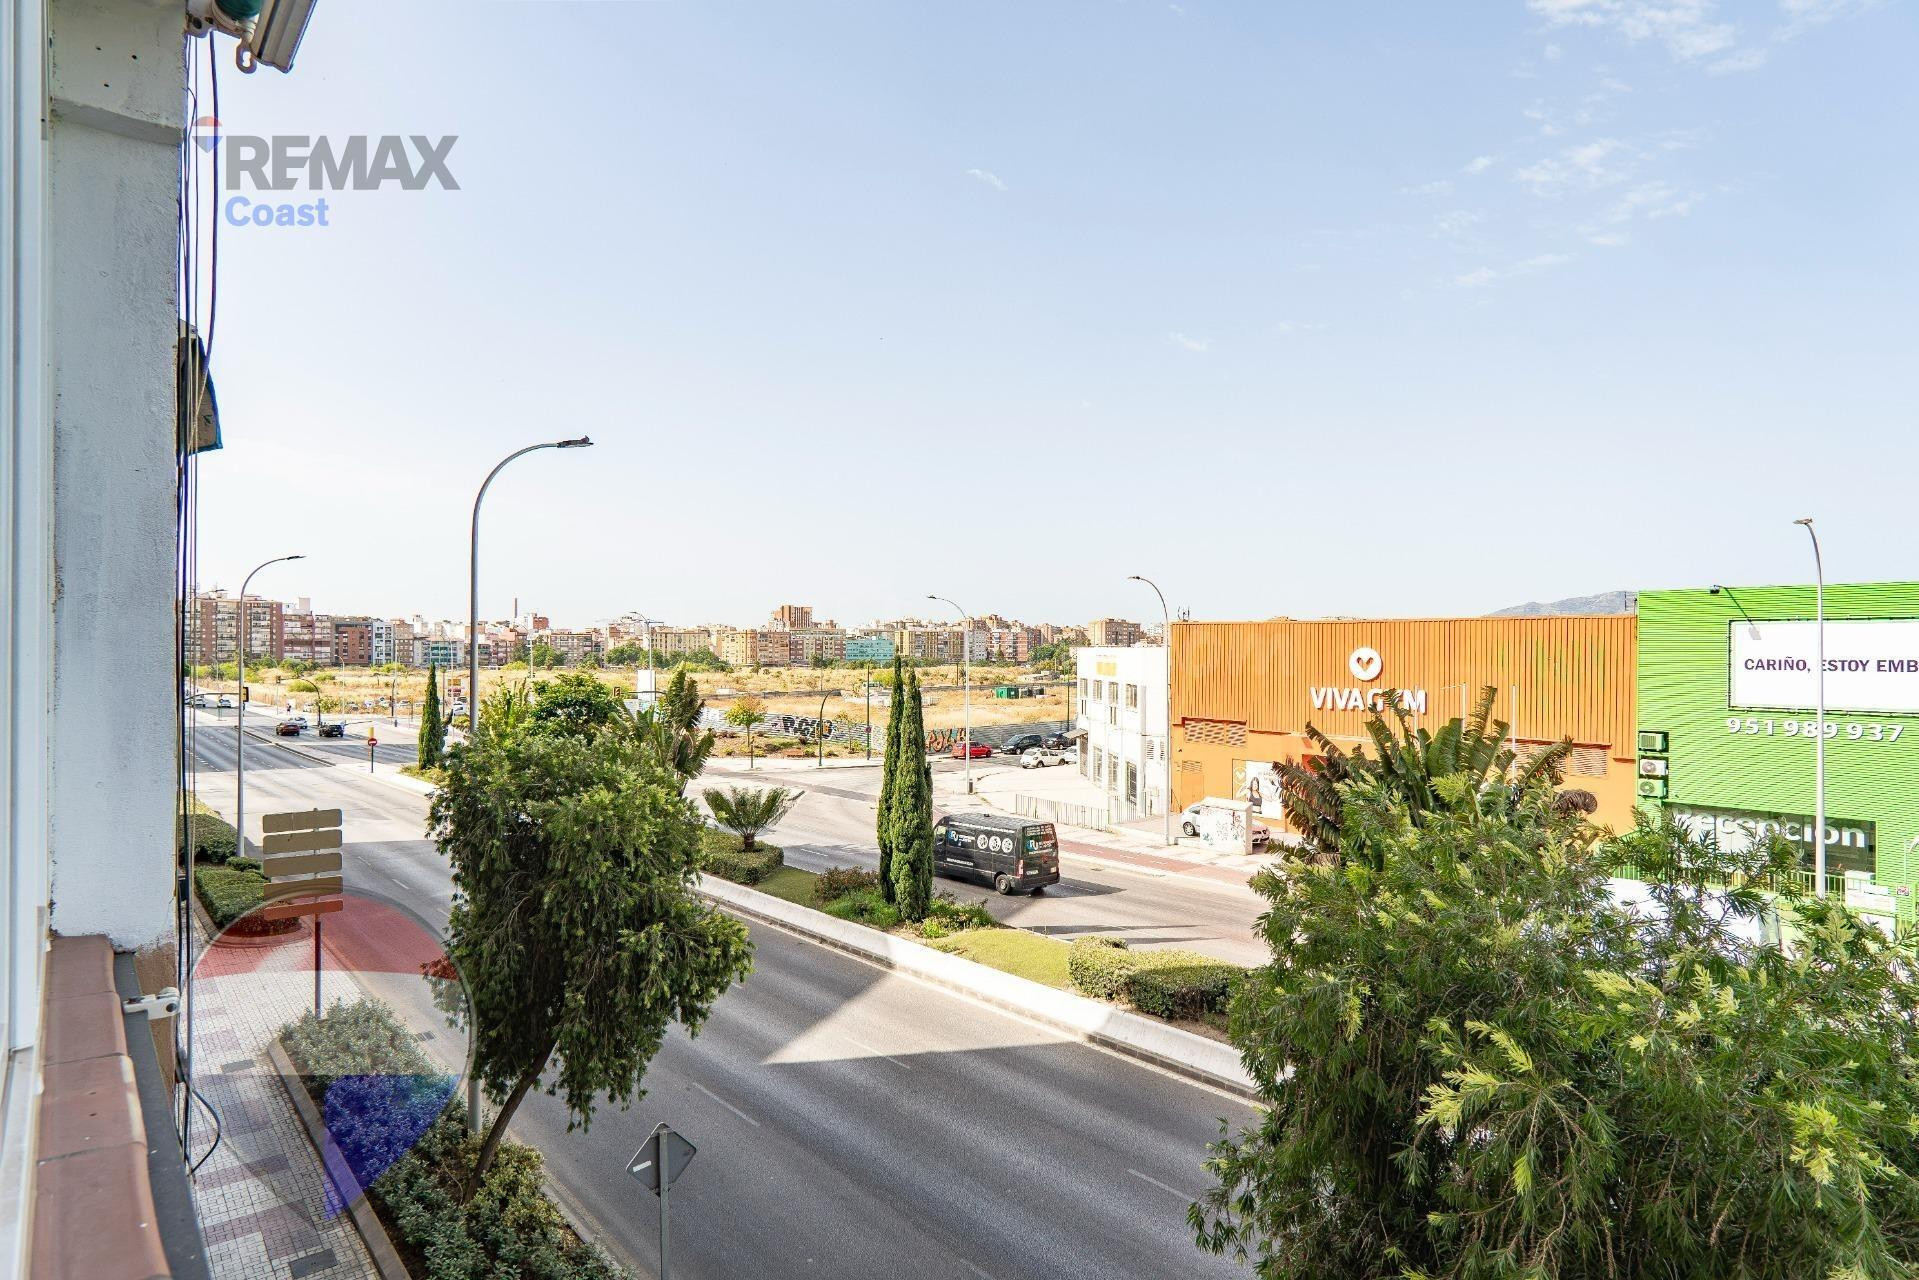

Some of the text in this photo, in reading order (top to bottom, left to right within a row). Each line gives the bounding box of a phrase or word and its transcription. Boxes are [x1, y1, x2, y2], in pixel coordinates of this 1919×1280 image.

[1744, 656, 1811, 673] CARIÑO,
[1728, 718, 1904, 742] 951 989 937
